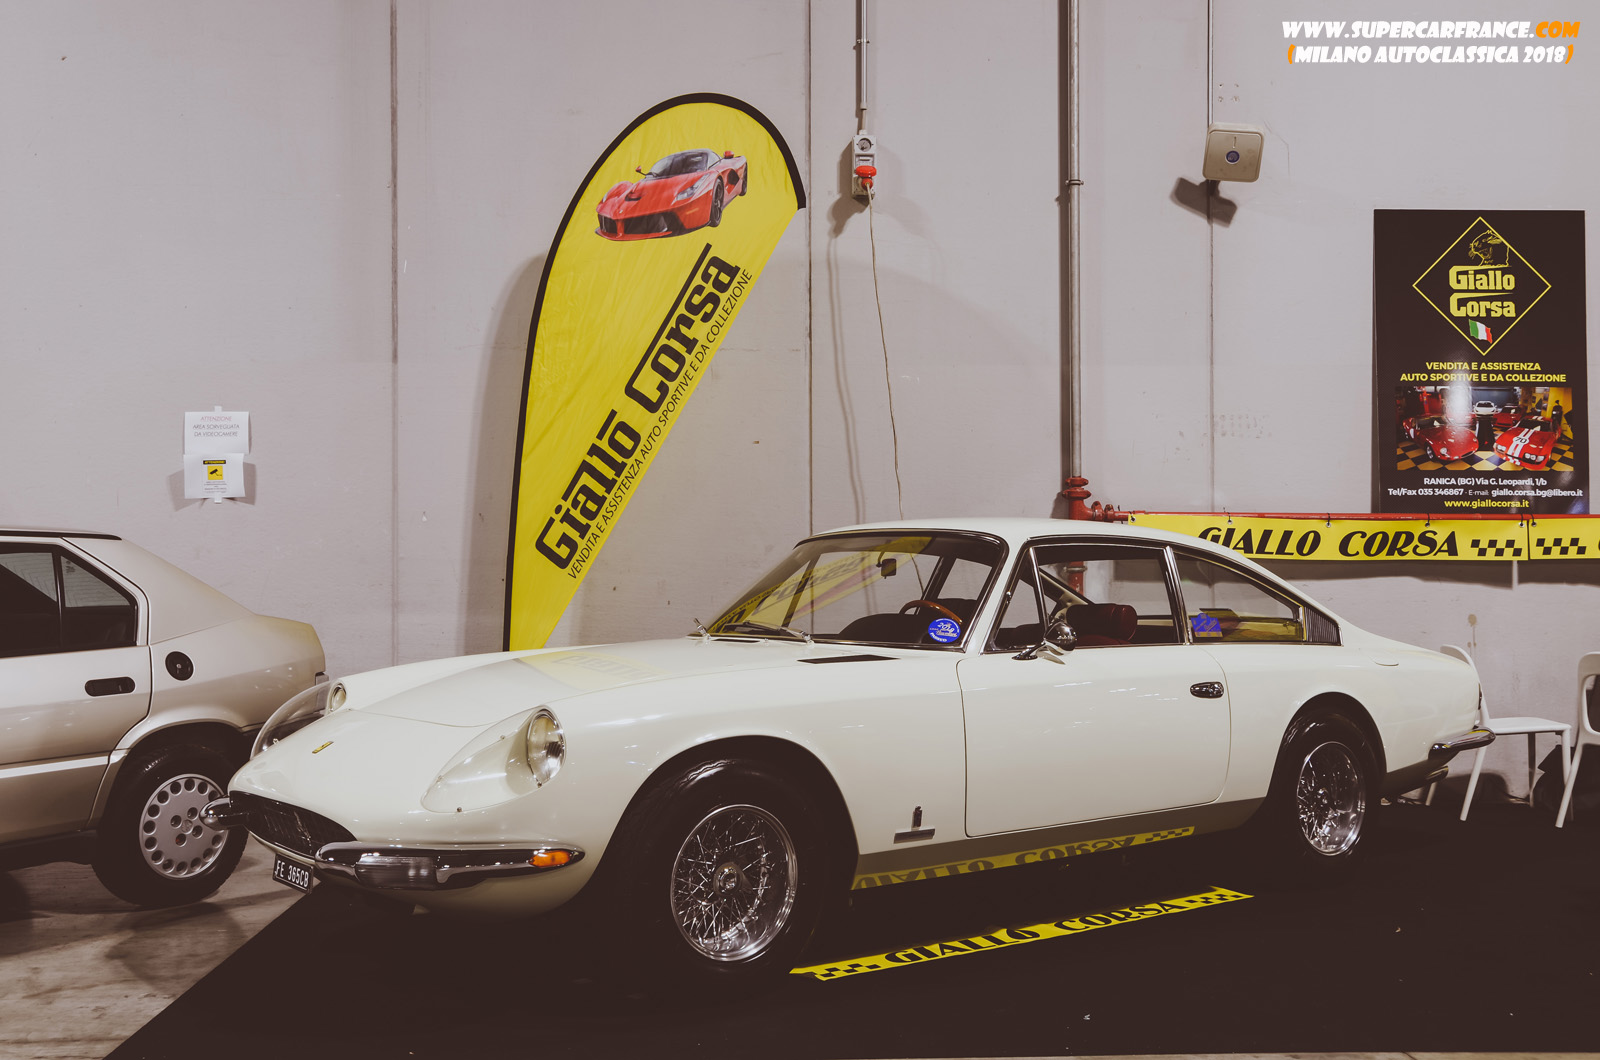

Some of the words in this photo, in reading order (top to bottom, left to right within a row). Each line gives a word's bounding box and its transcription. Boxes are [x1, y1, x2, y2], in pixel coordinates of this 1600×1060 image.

[1448, 265, 1516, 290] Giallo
[706, 268, 753, 344] COLLEZIONE
[1449, 292, 1516, 318] Corsa
[689, 360, 700, 373] E
[694, 344, 711, 364] DA
[1425, 361, 1470, 371] VENDITA
[1471, 361, 1478, 371] E
[1479, 361, 1542, 371] ASSISTENZA
[1400, 373, 1429, 382] AUTO
[1429, 373, 1480, 382] SPORTIVE
[1481, 373, 1488, 382] E
[1489, 373, 1505, 382] DA
[1505, 374, 1567, 383] COLLEZIONE
[535, 408, 642, 570] Giallo
[624, 242, 741, 414] Corsa
[658, 369, 695, 427] SPORTIVE
[640, 425, 662, 460] AUTO
[601, 458, 644, 526] ASSISTENZA
[1387, 487, 1417, 497] Tel/Fax
[1417, 488, 1433, 496] 035
[1433, 488, 1464, 496] 346867
[1491, 488, 1583, 498] giallo.corsa.bg@libero.it
[1423, 477, 1457, 485] RANICA
[1457, 477, 1475, 486] (BG)
[1475, 477, 1489, 485] Via
[1489, 478, 1498, 486] G.
[1498, 477, 1535, 487] Leopardi,
[1444, 498, 1530, 509] www.giallocorsa.it
[595, 521, 606, 534] E
[1338, 529, 1459, 557] CORSA
[567, 532, 601, 580] VENDITA
[884, 928, 1041, 964] GIALLO
[1053, 902, 1190, 931] CORSA
